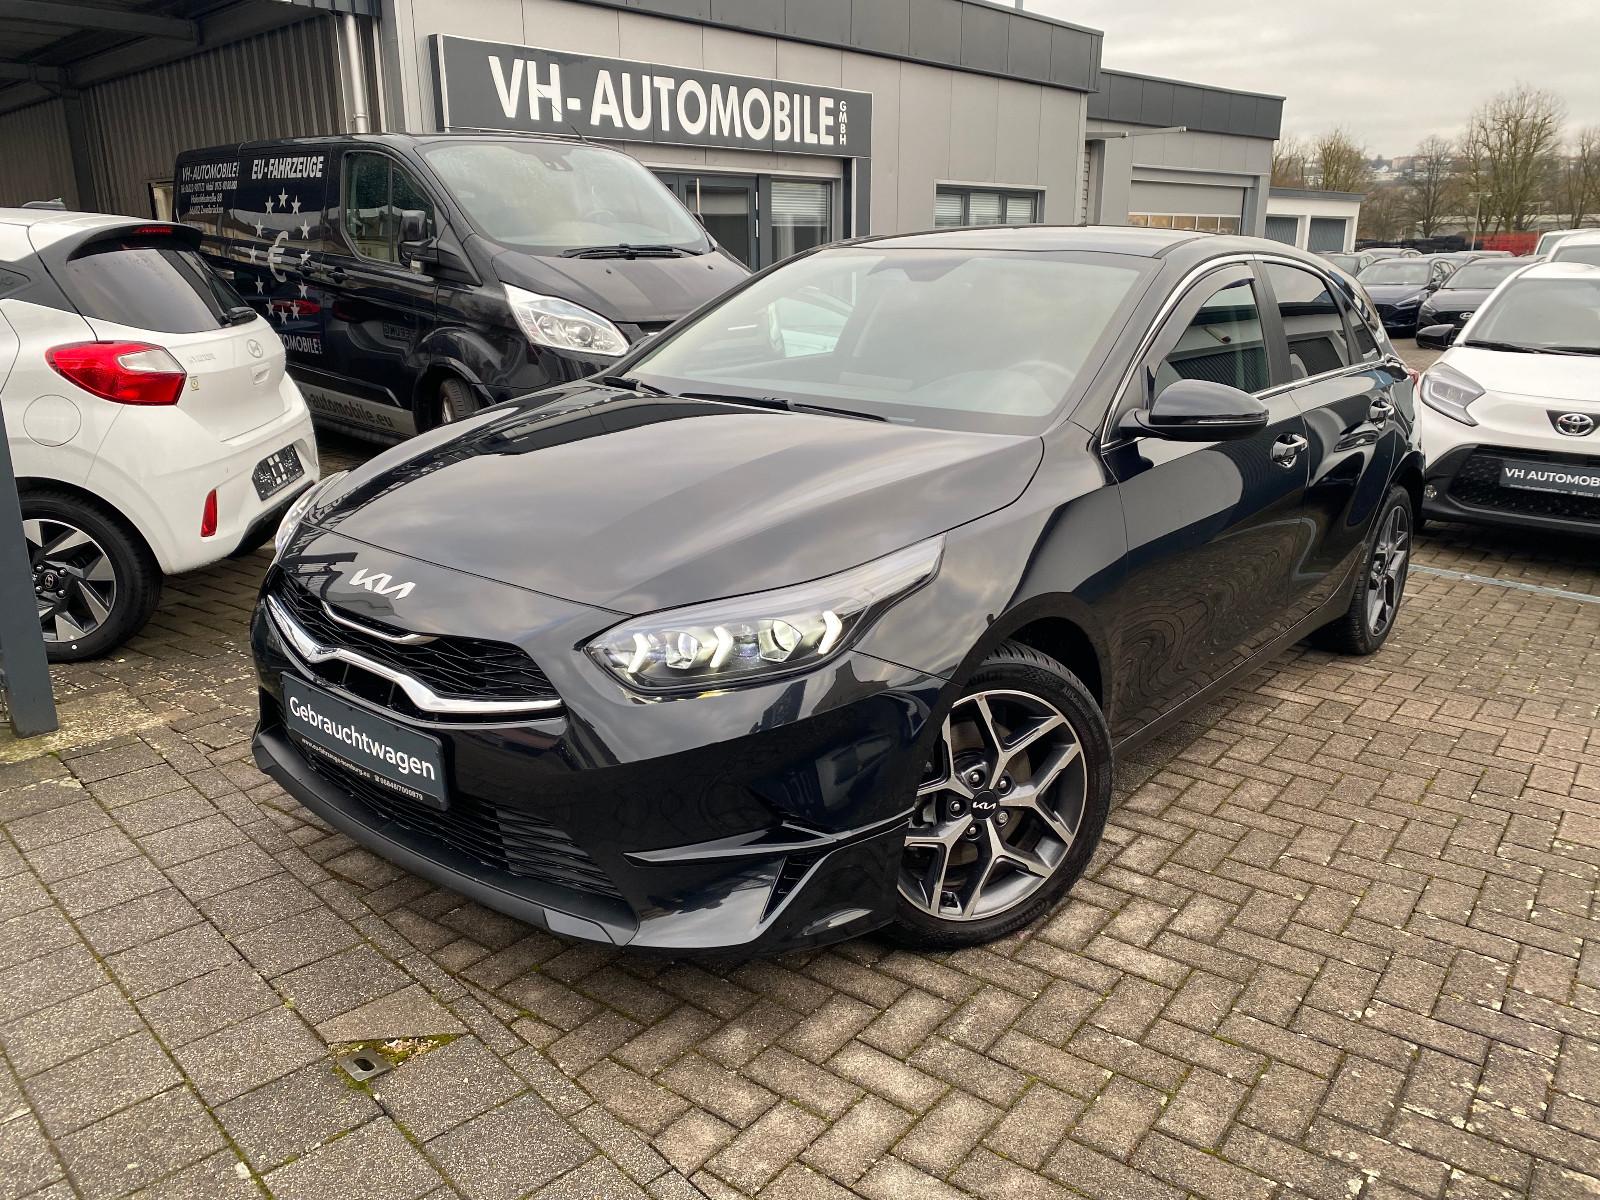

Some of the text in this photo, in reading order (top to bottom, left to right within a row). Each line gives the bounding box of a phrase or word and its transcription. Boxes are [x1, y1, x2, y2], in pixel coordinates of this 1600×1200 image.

[590, 69, 835, 146] AUTOMOBILE
[838, 100, 848, 146] GMBH
[251, 155, 325, 180] EU-FAHRZEUGE
[1504, 467, 1525, 479] VH
[288, 696, 436, 781] Gebrauchtwagen
